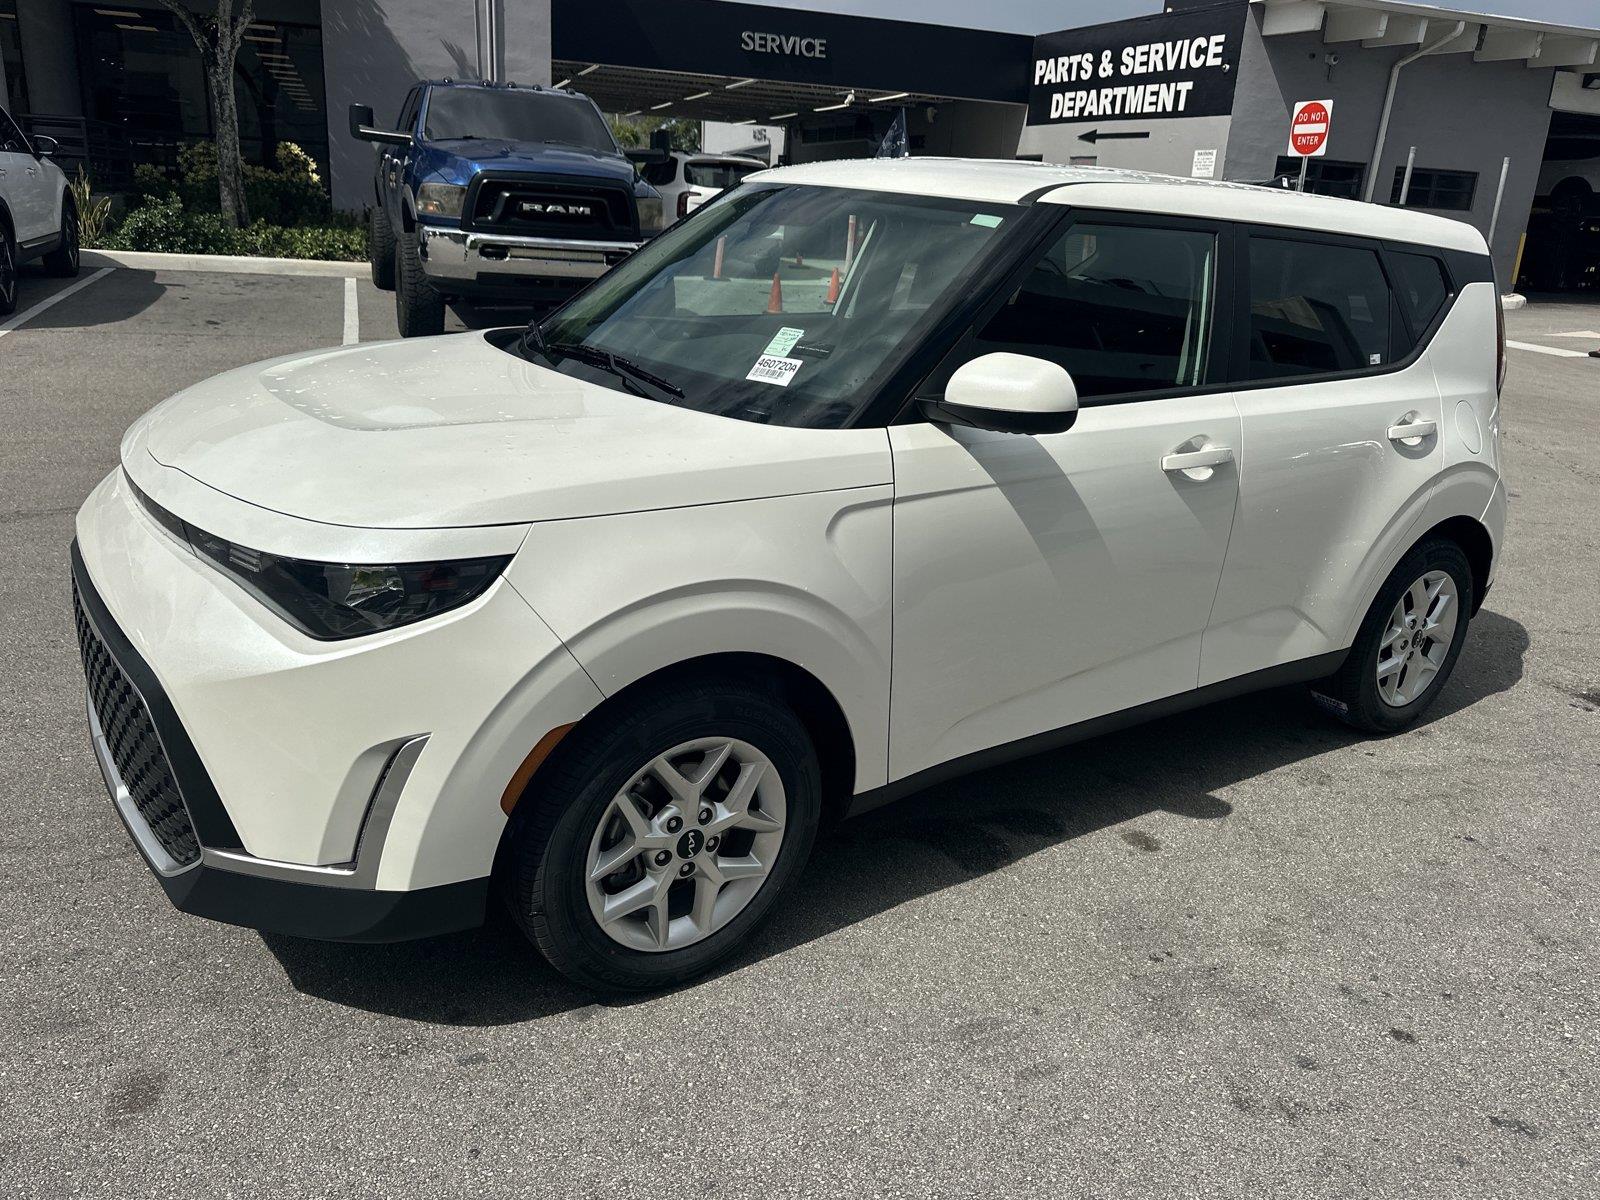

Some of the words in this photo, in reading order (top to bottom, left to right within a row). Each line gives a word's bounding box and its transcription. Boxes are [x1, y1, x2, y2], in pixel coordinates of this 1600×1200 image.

[741, 31, 827, 59] SERVICE
[1034, 52, 1094, 86] PARTS
[1098, 49, 1114, 79] &
[1120, 34, 1226, 76] SERVICE
[1050, 81, 1194, 119] DEPARTMENT
[1298, 113, 1309, 122] DO
[1310, 111, 1326, 122] NOT
[1297, 135, 1319, 146] ENTER
[522, 202, 591, 215] RAM
[757, 358, 798, 373] 460720A
